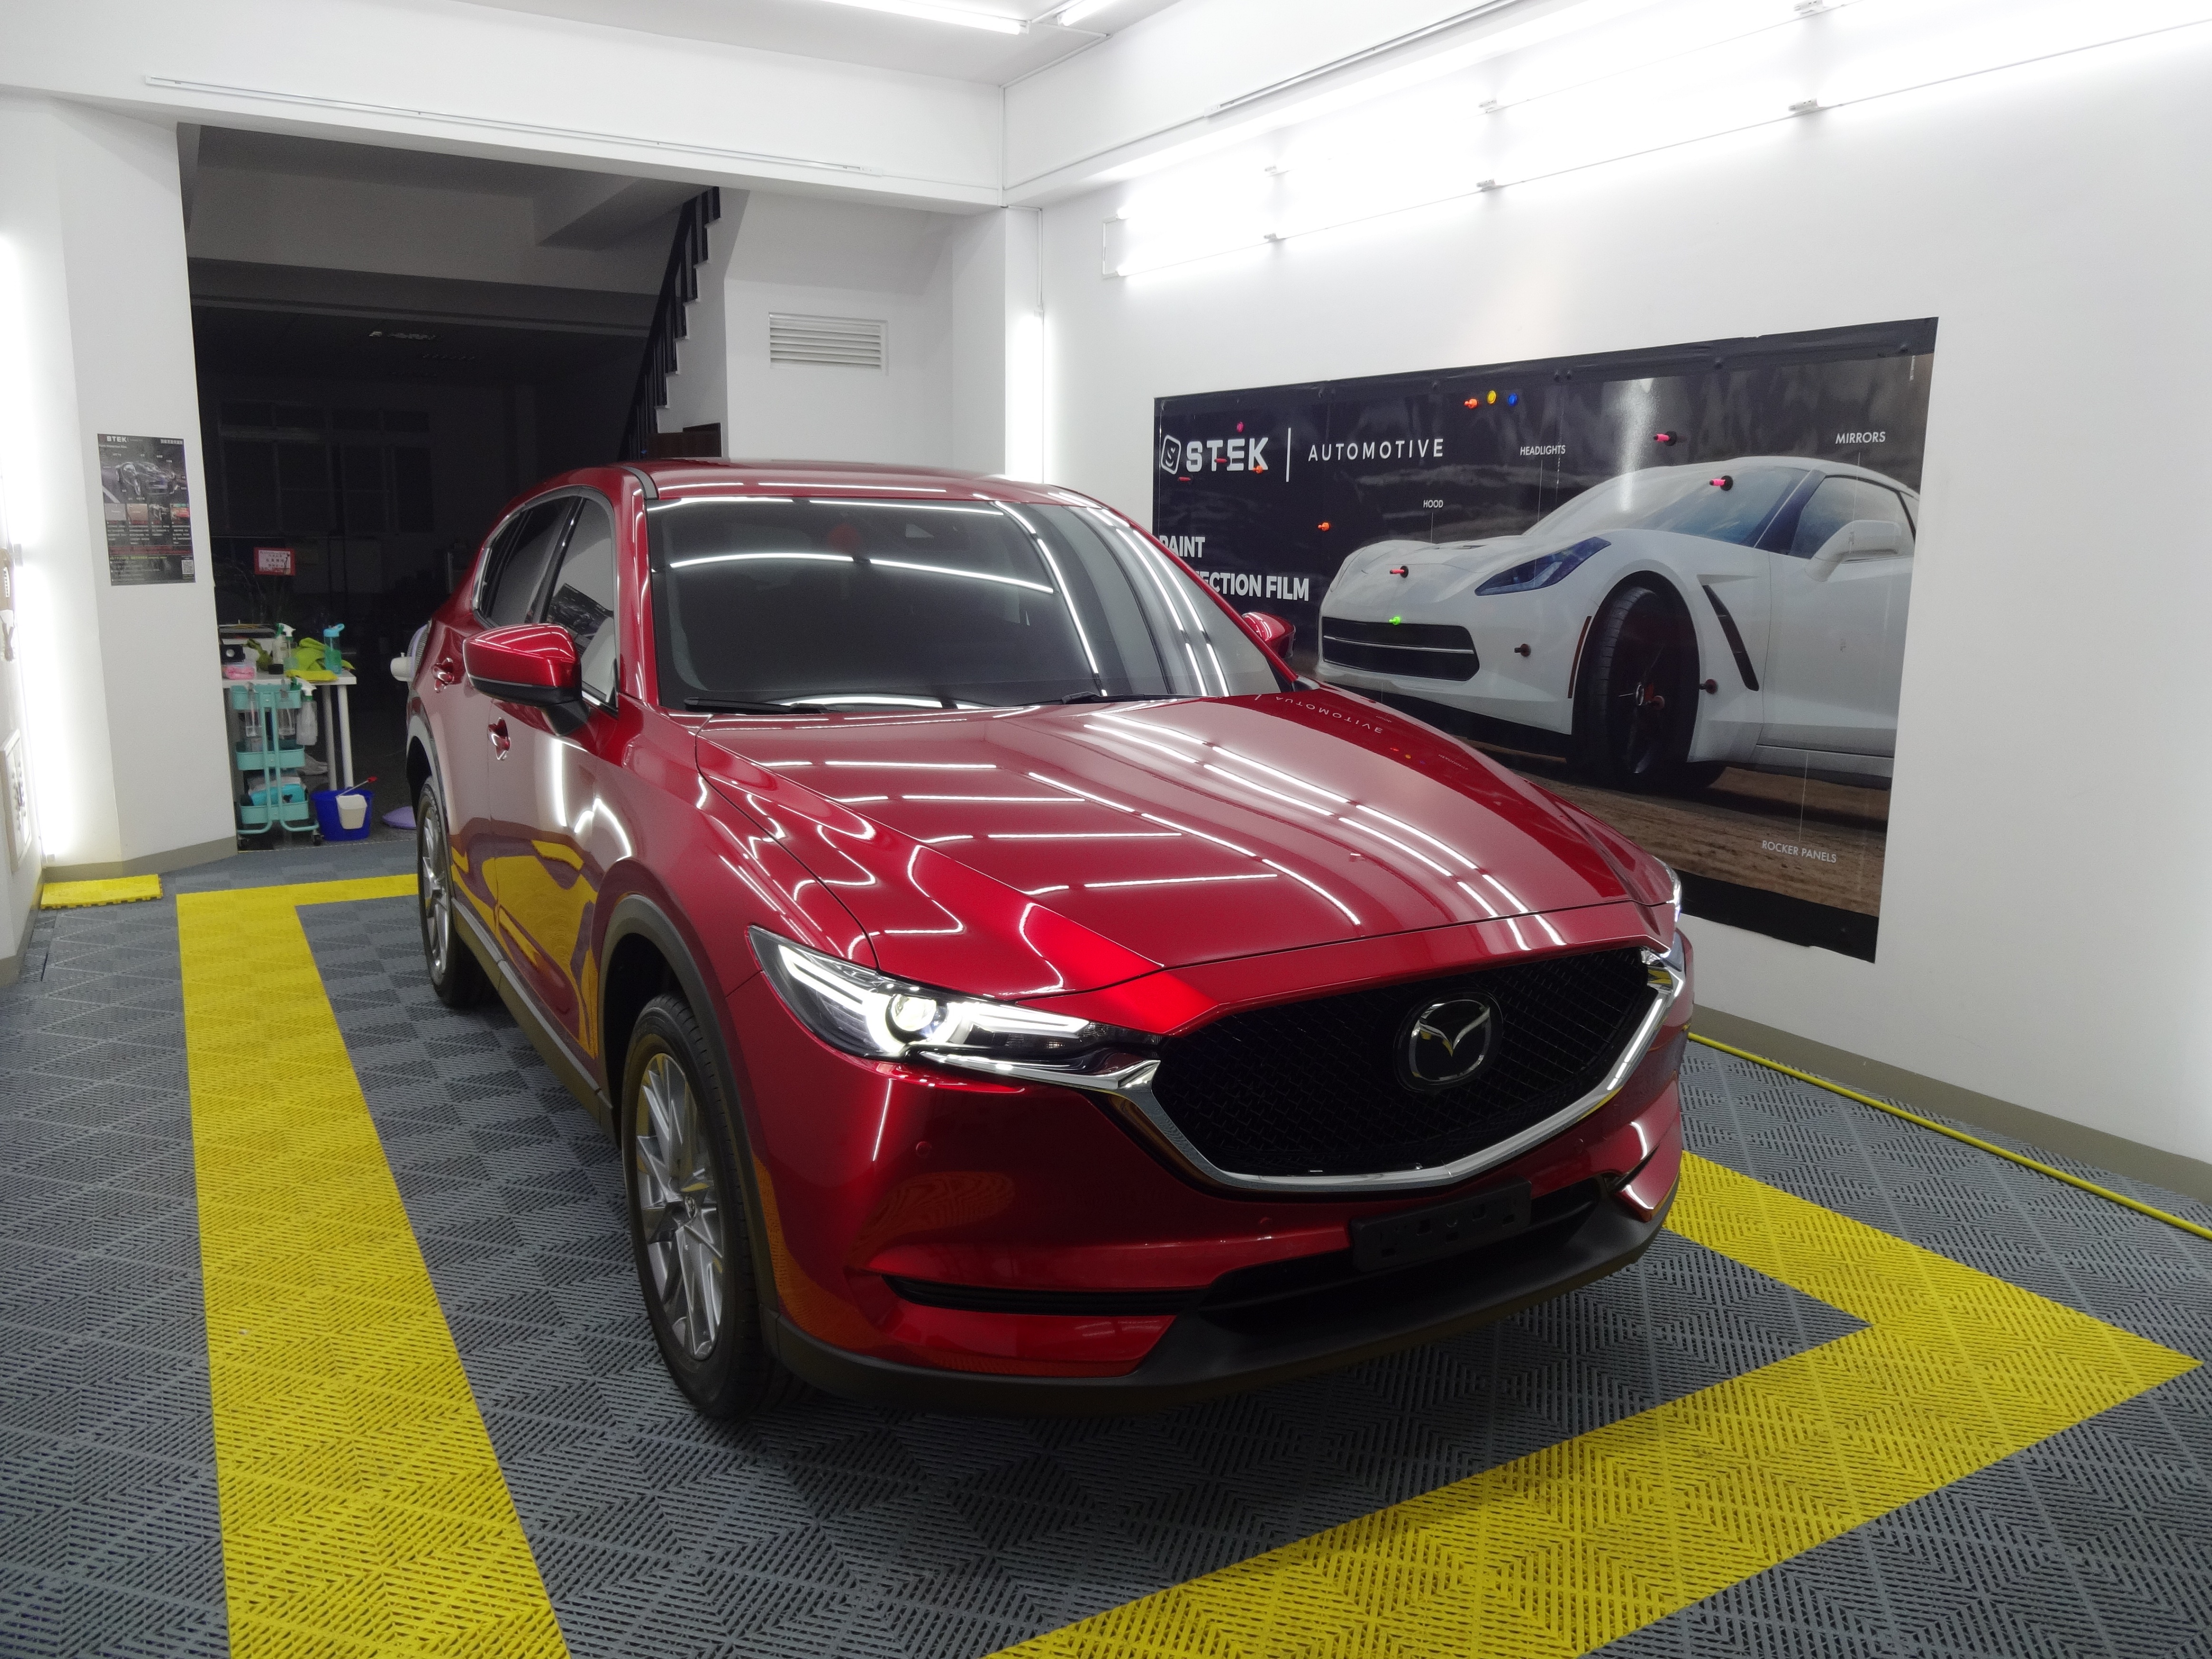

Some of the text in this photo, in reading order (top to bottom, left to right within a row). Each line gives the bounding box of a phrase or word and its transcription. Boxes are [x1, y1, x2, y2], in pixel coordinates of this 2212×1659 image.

[1835, 431, 1886, 444] MIRRORS
[1186, 437, 1444, 472] STEK AUTOMOTIVE
[1520, 445, 1566, 456] HEADLIGHTS
[1423, 499, 1444, 508] HOOD
[1266, 575, 1309, 602] FILM
[1762, 840, 1837, 863] ROCKER PANELS
